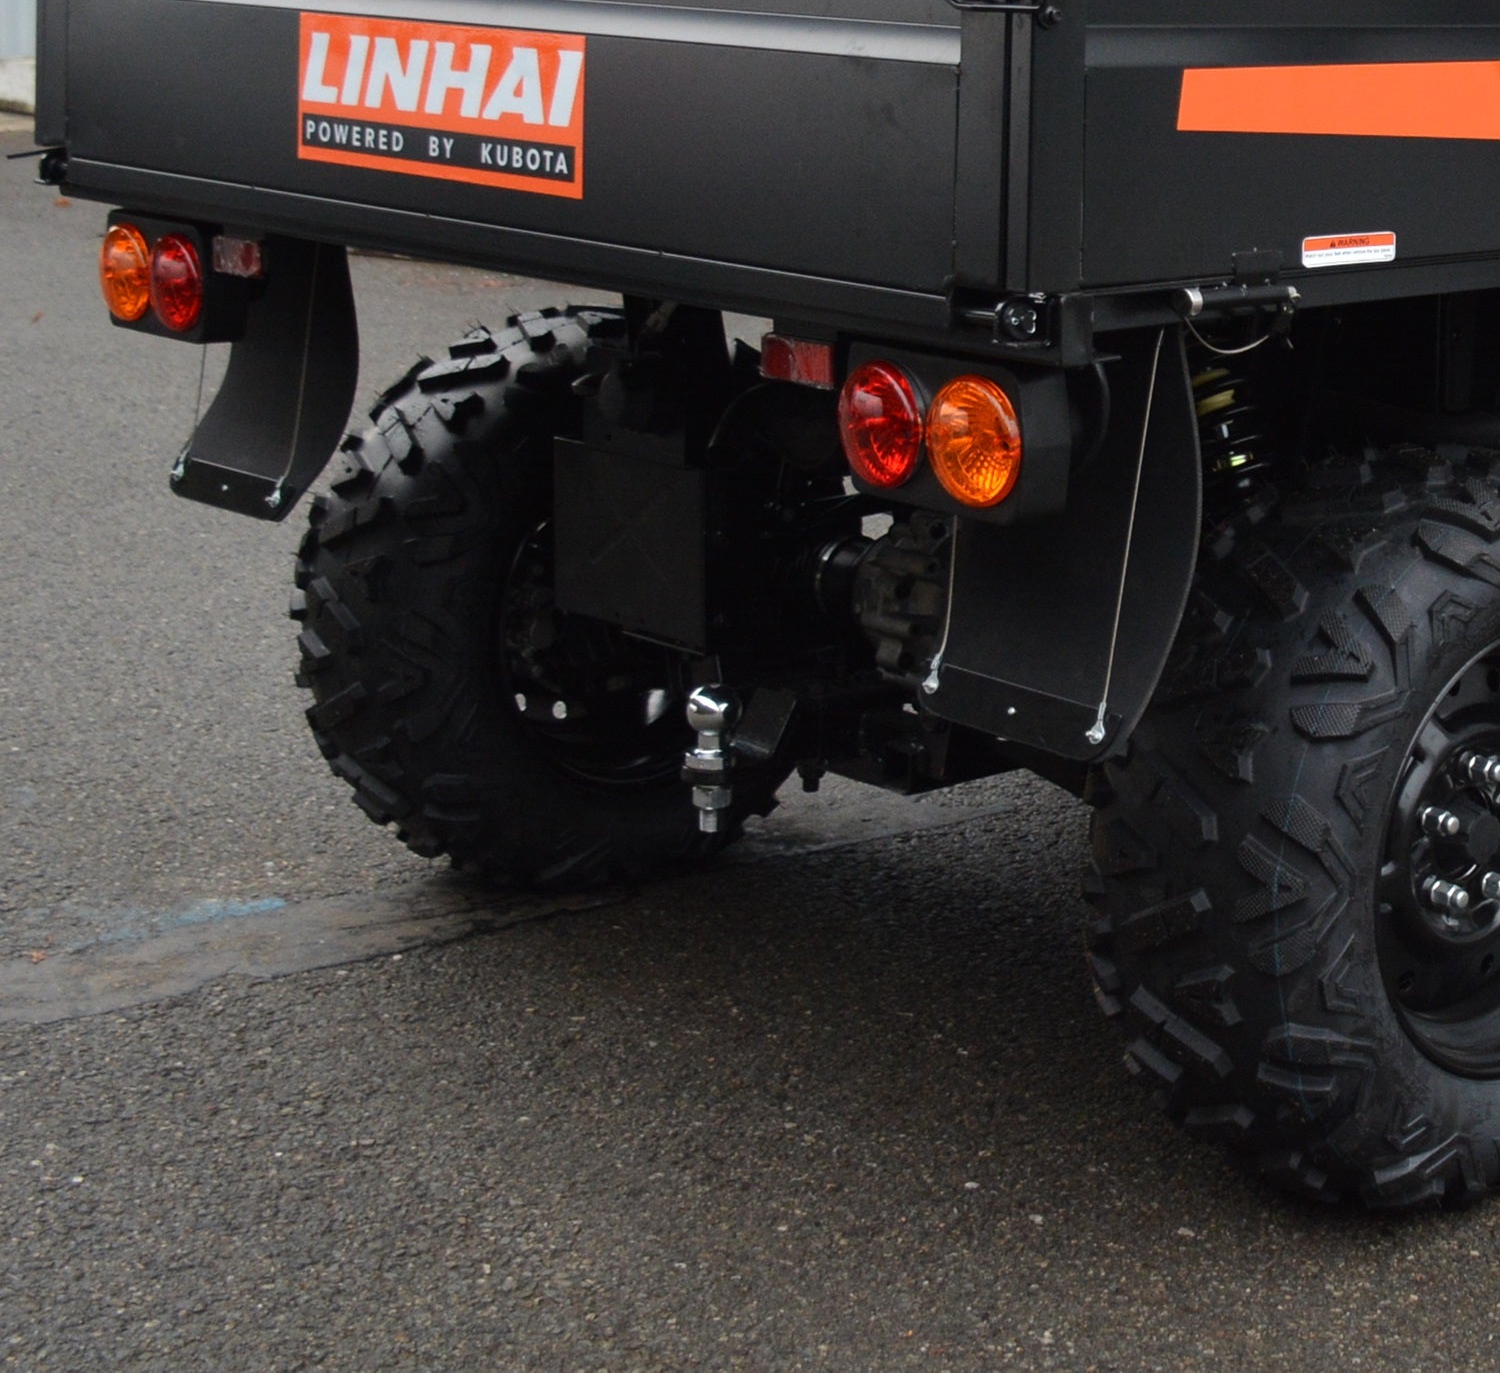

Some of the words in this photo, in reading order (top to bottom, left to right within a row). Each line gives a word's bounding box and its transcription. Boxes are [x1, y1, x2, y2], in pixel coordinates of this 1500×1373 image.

[302, 32, 583, 127] LINHAI
[306, 119, 404, 152] POWERED
[429, 135, 454, 158] BY
[481, 142, 568, 175] KUBOTA
